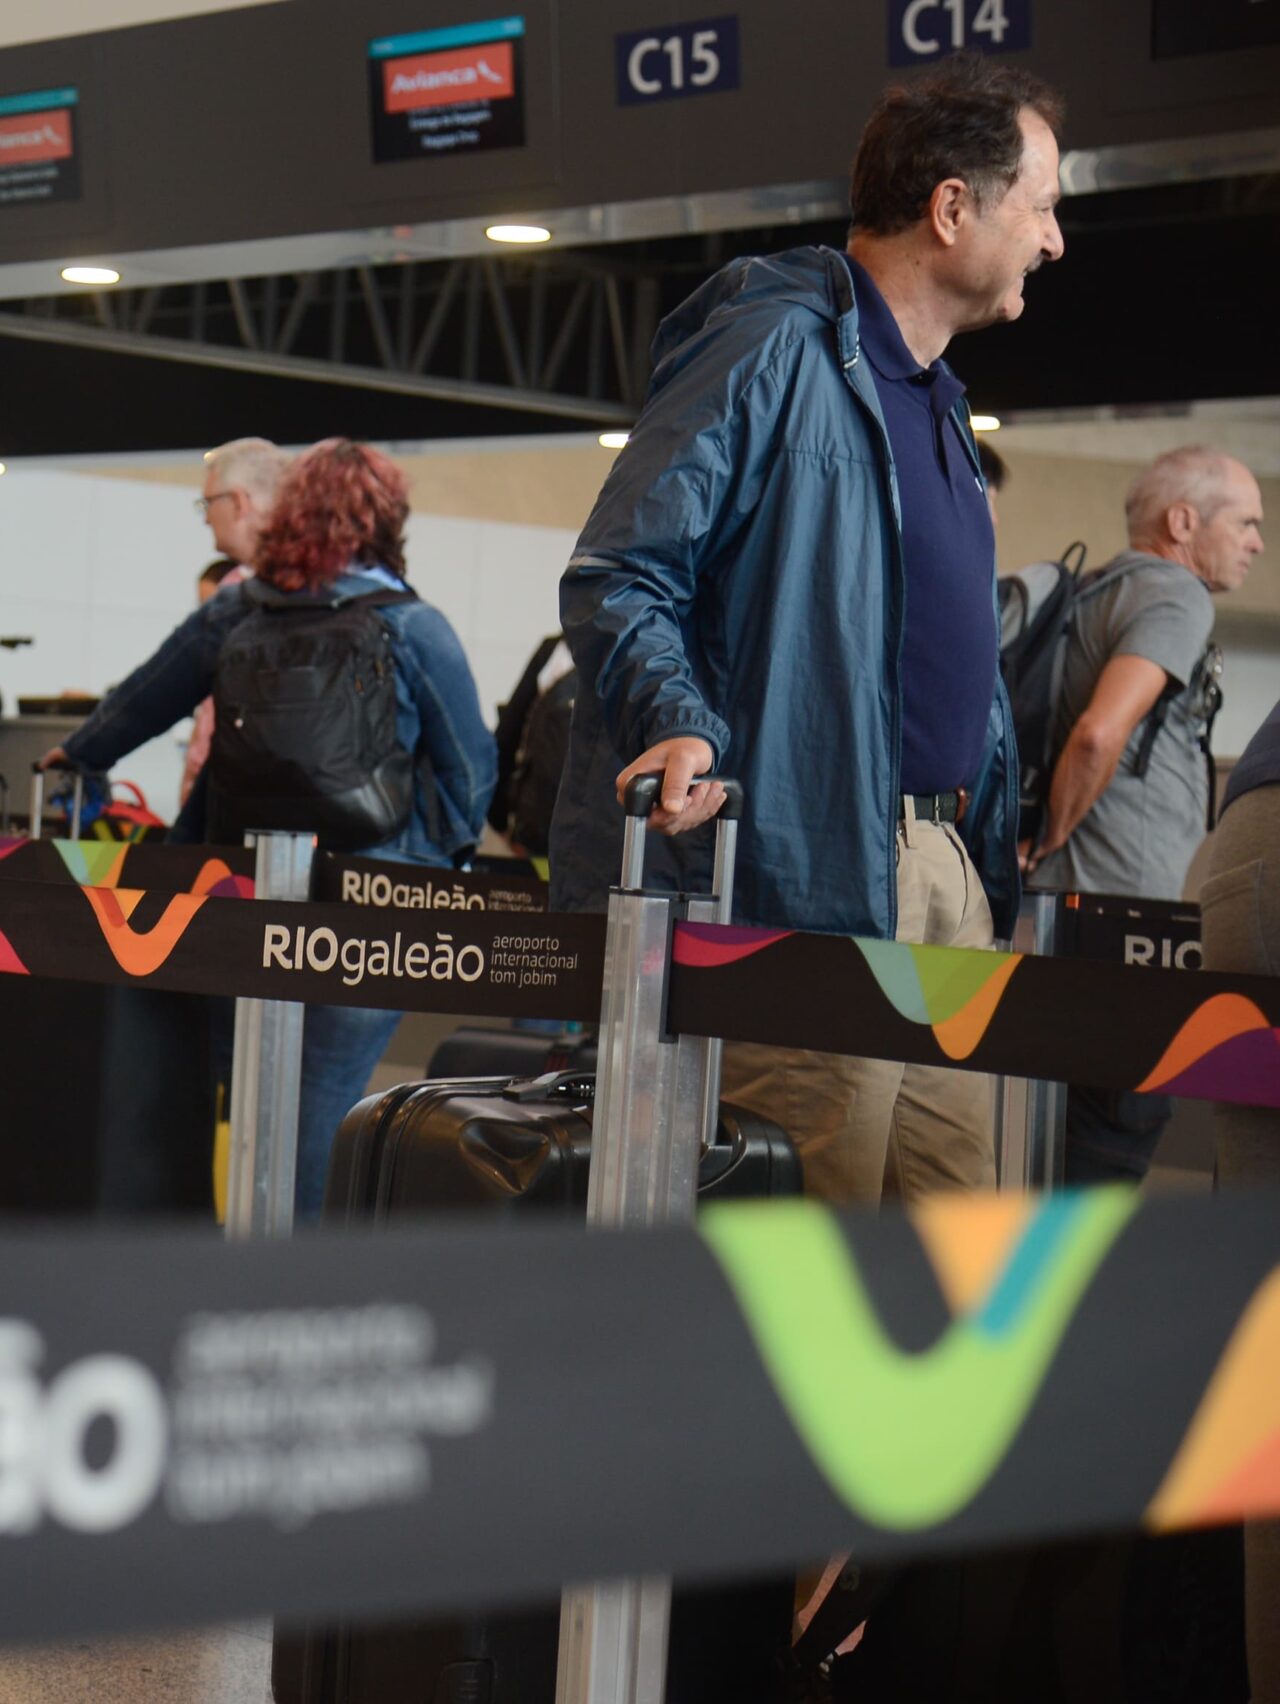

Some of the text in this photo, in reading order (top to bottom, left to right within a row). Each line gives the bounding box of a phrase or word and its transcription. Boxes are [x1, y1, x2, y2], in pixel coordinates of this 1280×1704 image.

[901, 0, 1010, 55] C14
[627, 29, 720, 95] C15
[391, 65, 478, 95] Avianca
[262, 923, 485, 986] RIOgaleão
[492, 935, 560, 953] aeroporto
[490, 949, 578, 970] internacional
[490, 968, 557, 988] tom jobim
